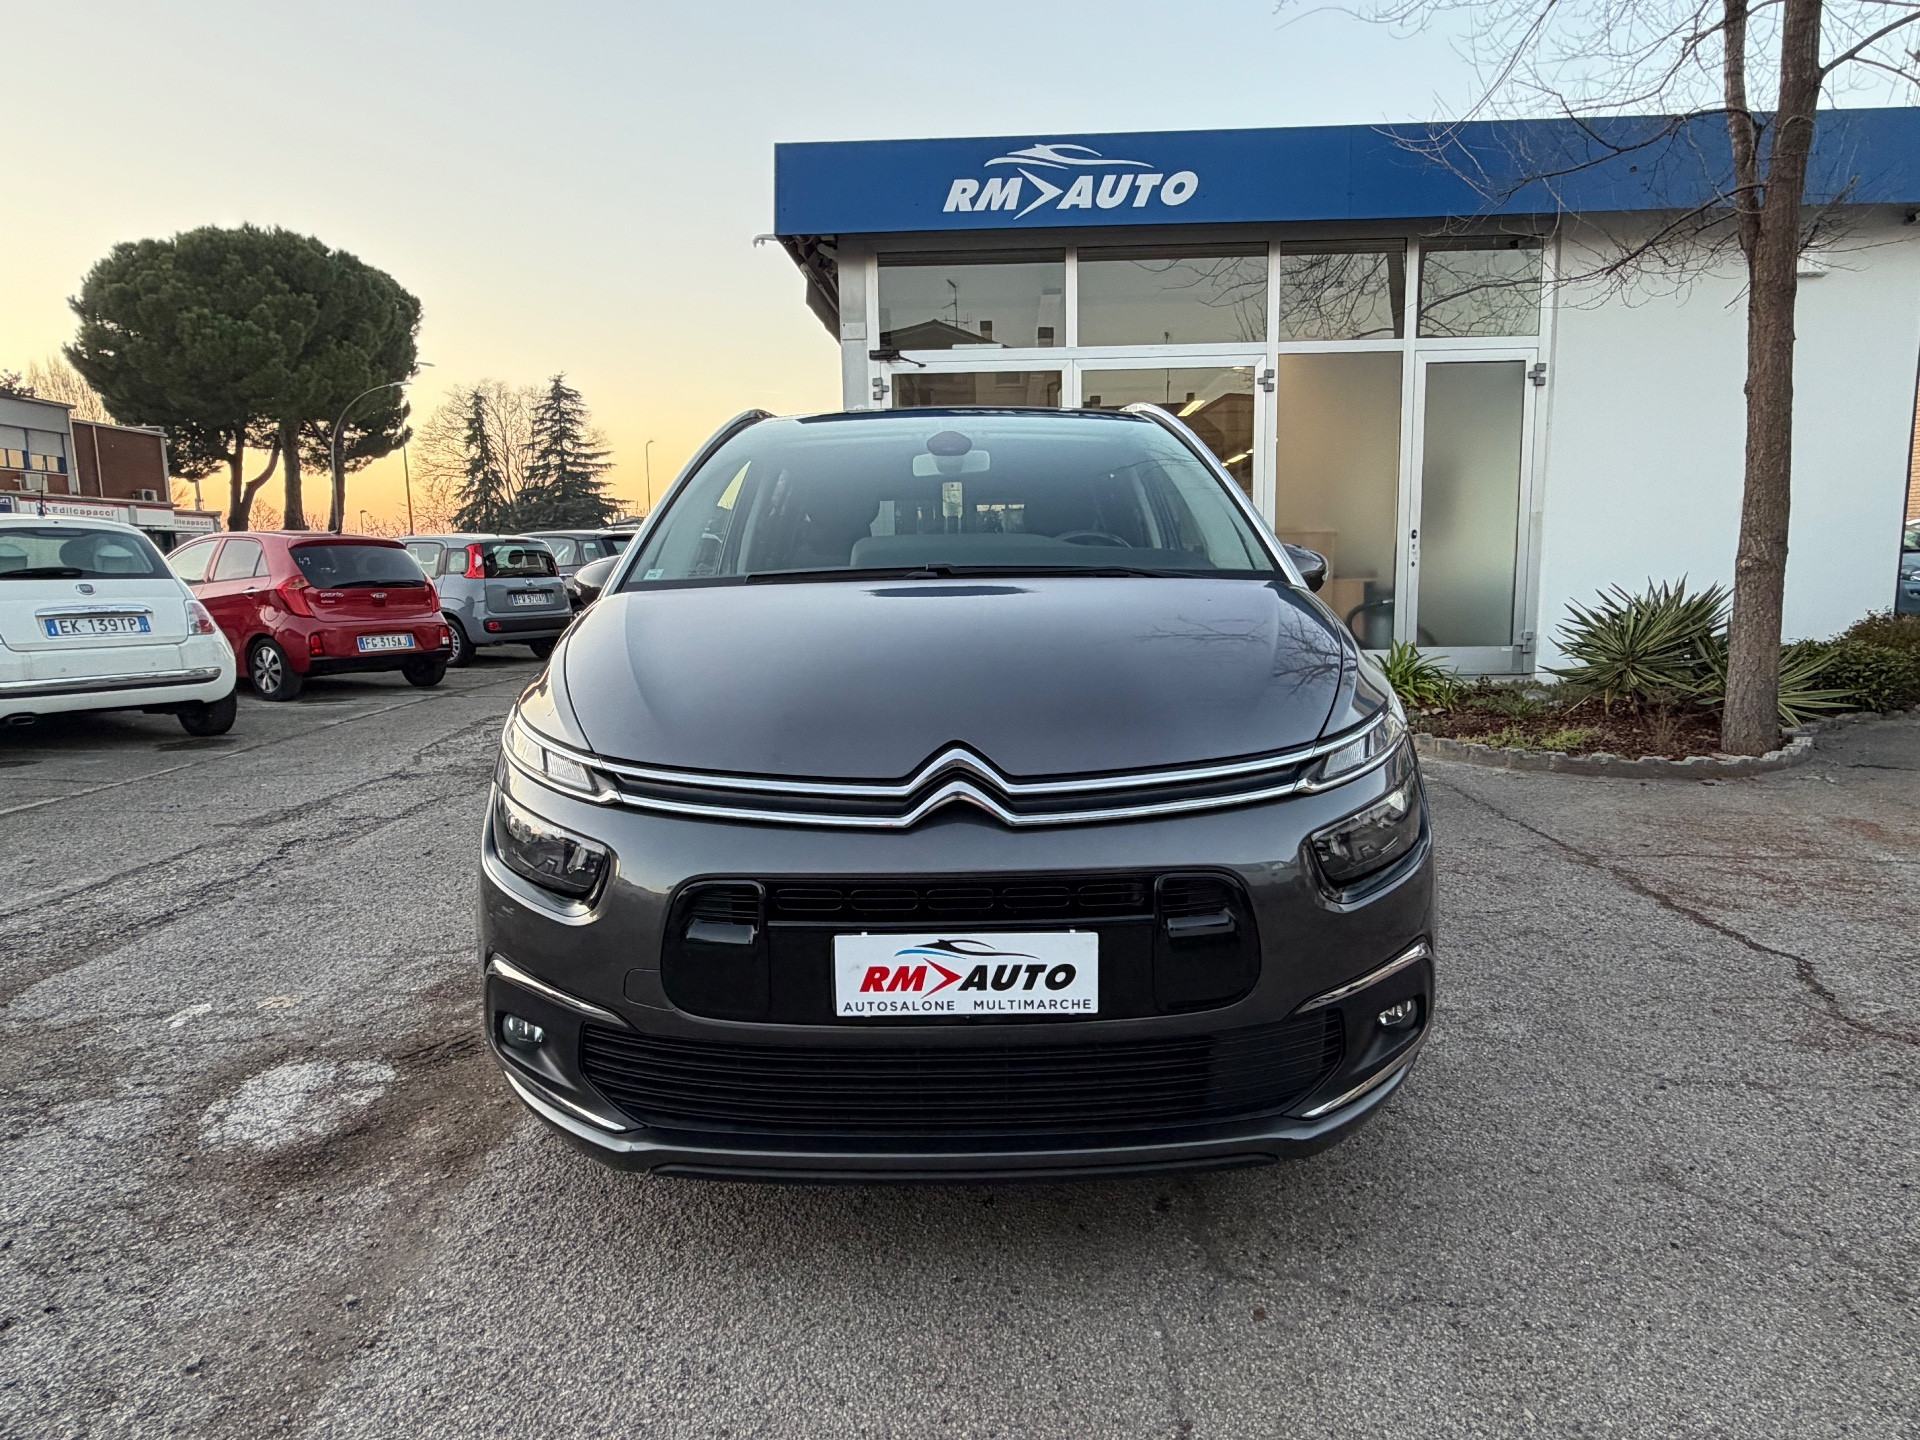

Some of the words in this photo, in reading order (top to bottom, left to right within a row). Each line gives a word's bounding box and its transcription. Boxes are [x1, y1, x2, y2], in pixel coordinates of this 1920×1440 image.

[1056, 170, 1199, 210] AUTO
[58, 620, 82, 634] EK
[88, 618, 137, 633] 139TP
[957, 963, 1077, 991] AUTO
[843, 1000, 956, 1013] AUTOSALONE
[973, 998, 1092, 1012] MULTIMARCHE
